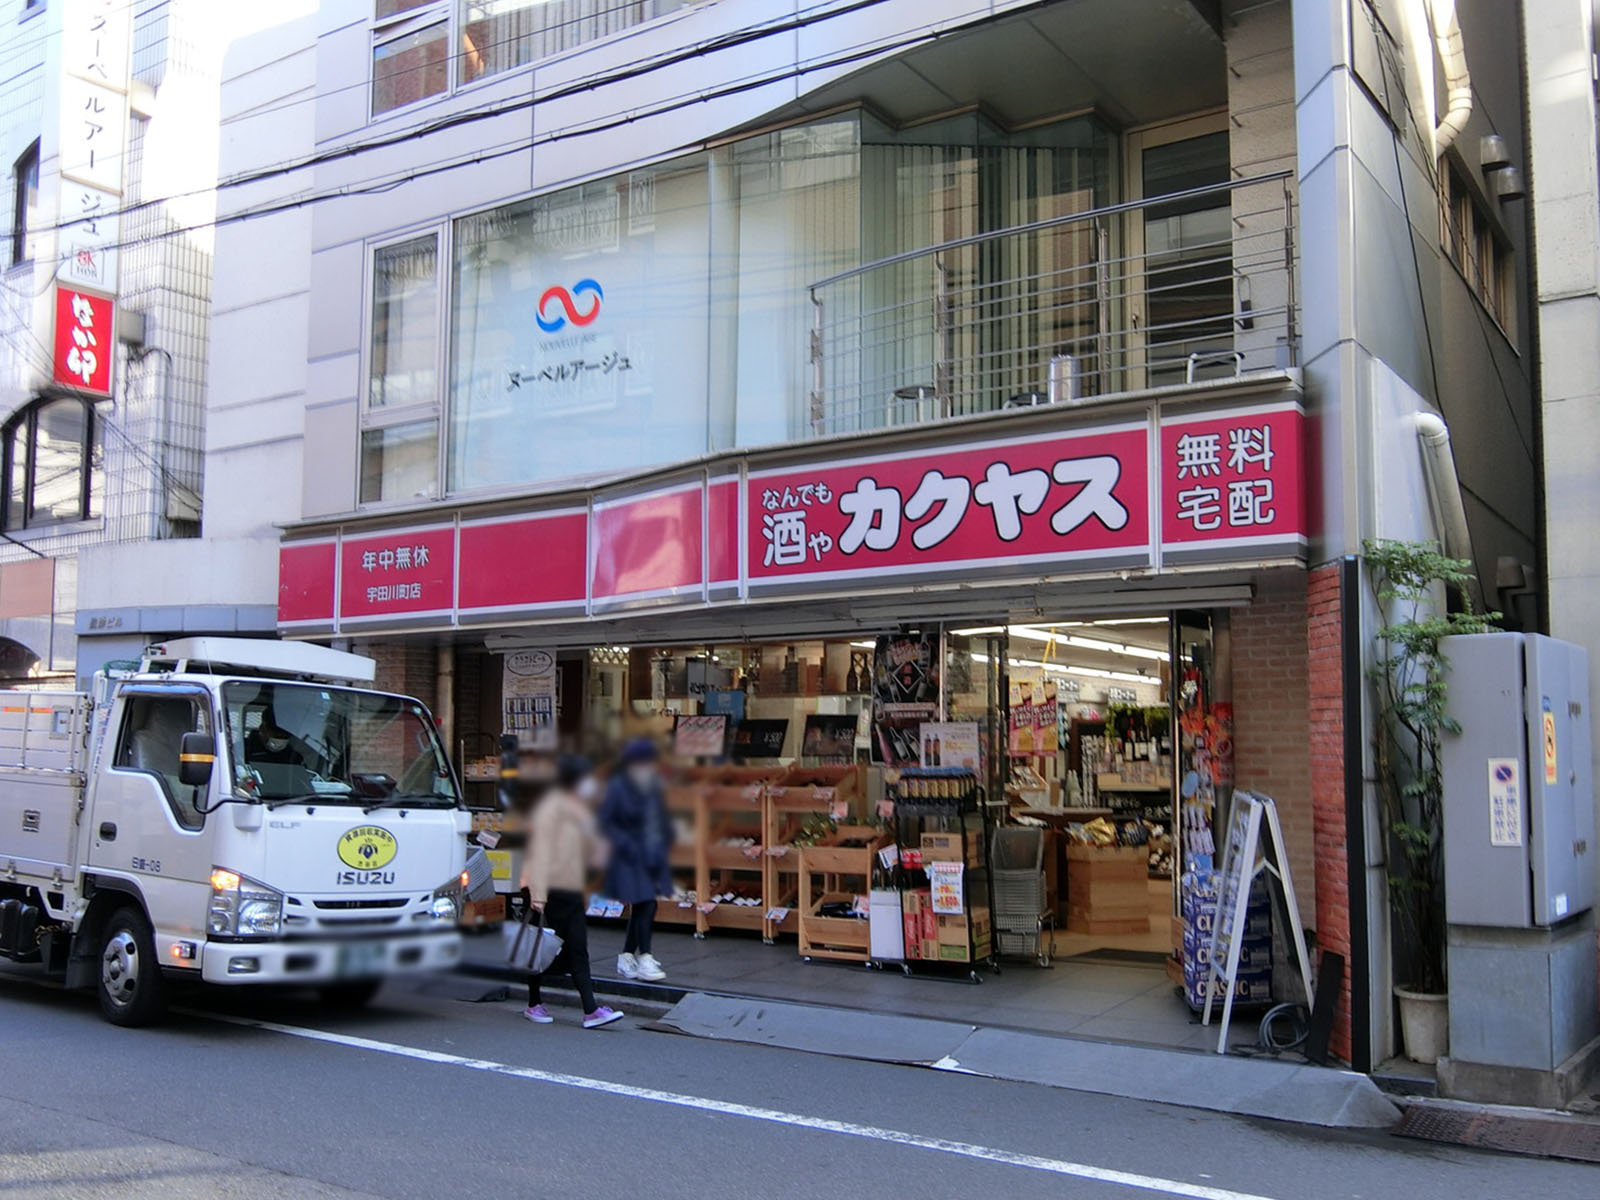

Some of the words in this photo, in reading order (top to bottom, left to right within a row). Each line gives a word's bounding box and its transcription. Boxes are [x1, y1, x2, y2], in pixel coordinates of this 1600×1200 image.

[66, 292, 97, 387] なか卯
[506, 351, 633, 393] ヌーベルアージュ
[1177, 424, 1275, 480] 無料
[762, 481, 833, 510] なんでも
[838, 455, 1129, 555] カクヤス
[1177, 478, 1275, 531] 宅配
[361, 544, 430, 573] 年中無休
[762, 509, 833, 567] 酒や
[366, 582, 422, 603] 宇田川町店
[336, 871, 396, 886] ISUZU
[1196, 980, 1249, 997] CASIC
